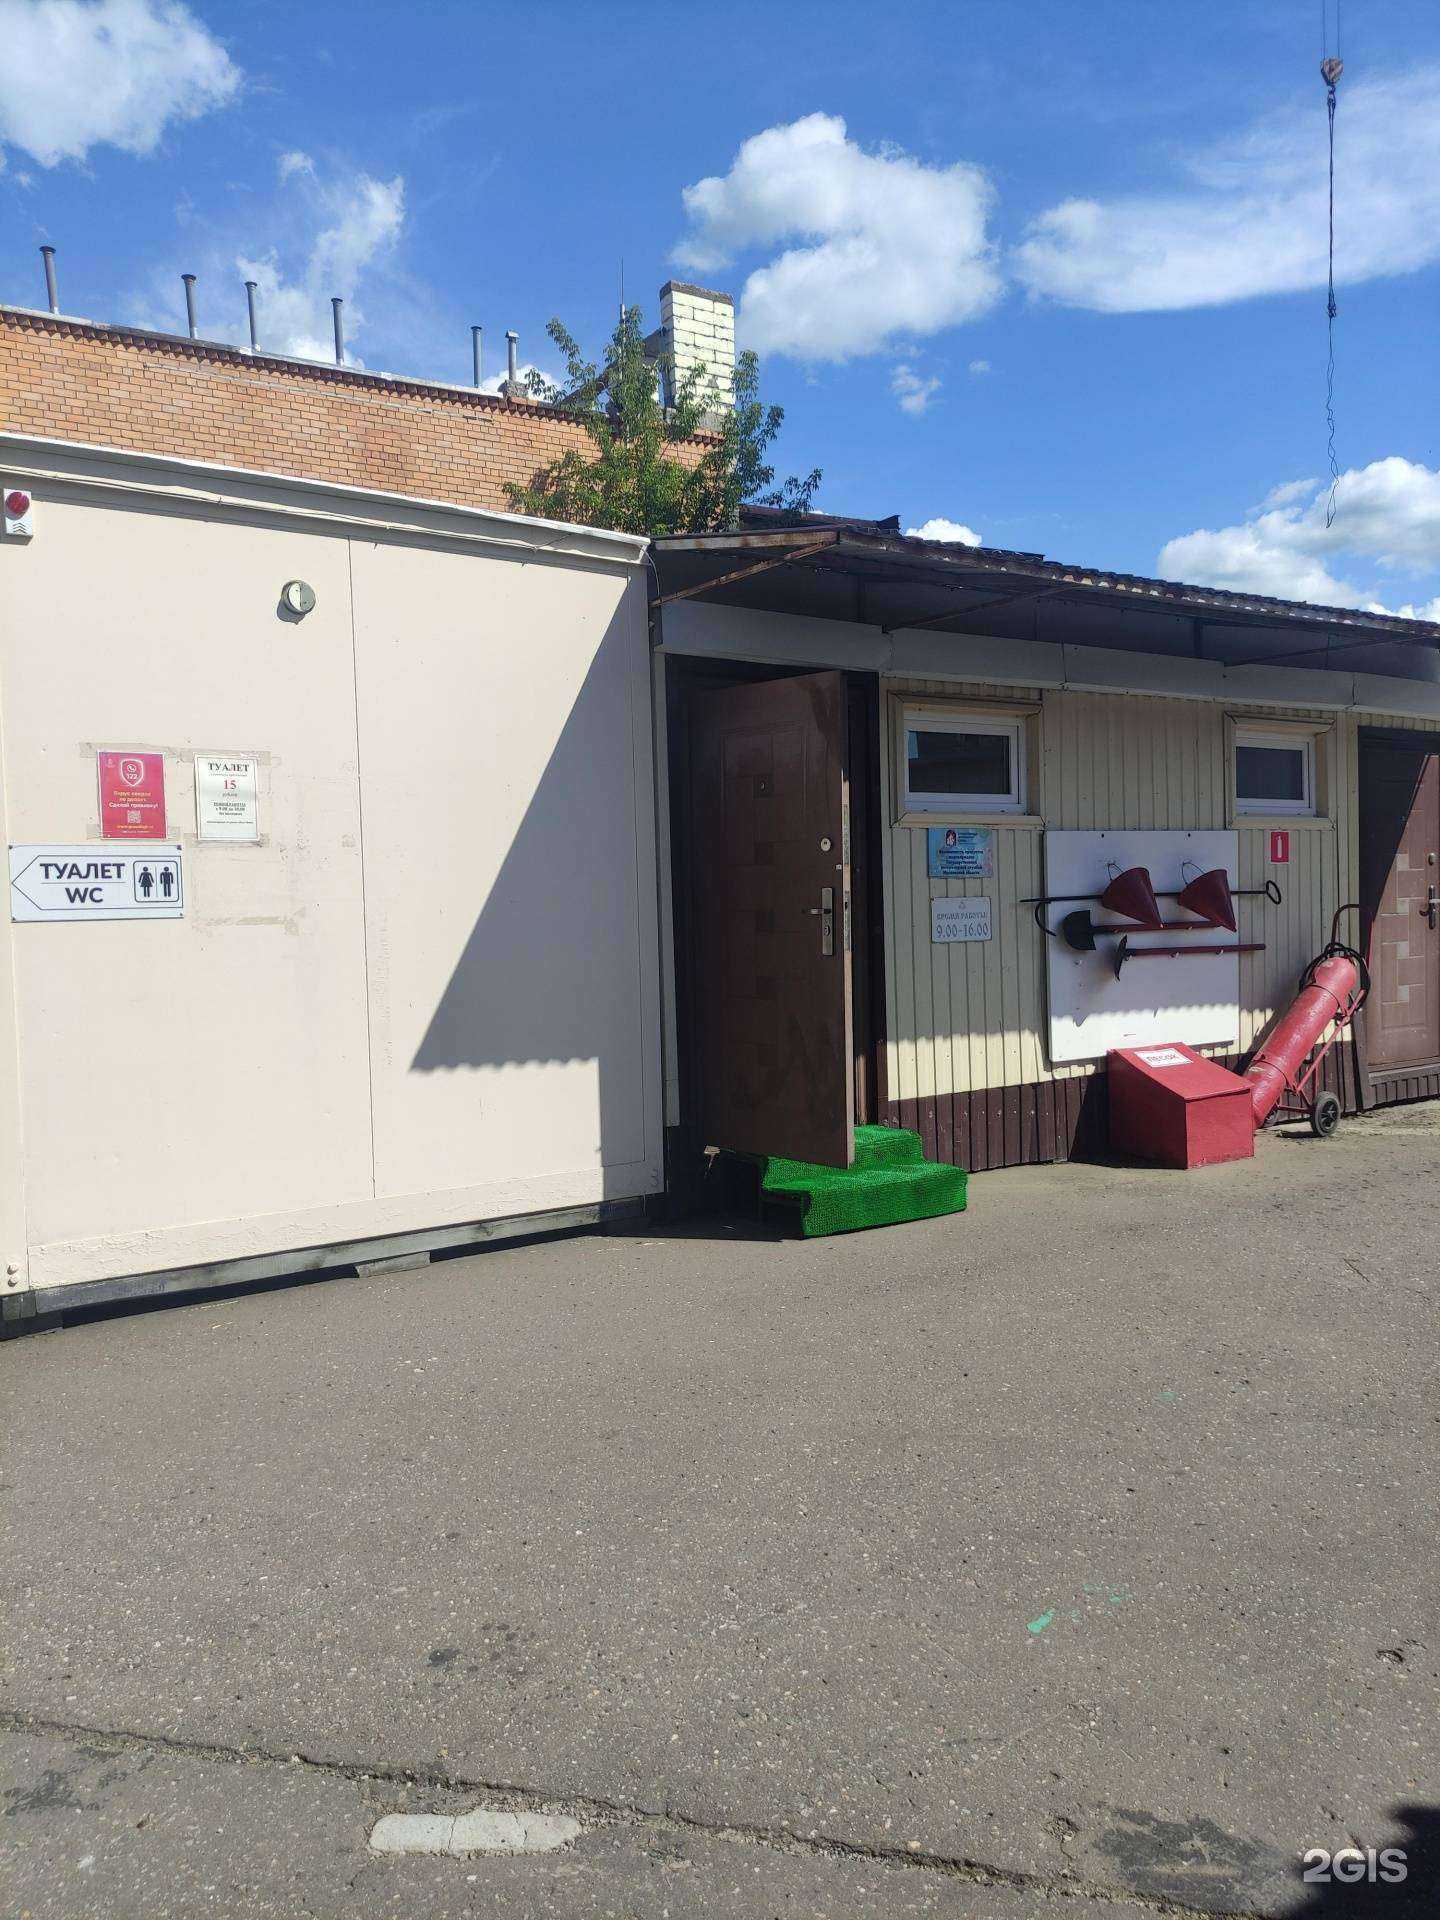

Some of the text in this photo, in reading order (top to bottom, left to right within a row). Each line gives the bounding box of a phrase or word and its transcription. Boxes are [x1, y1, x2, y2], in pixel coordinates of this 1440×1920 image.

[207, 762, 249, 772] ТУАЛЕТ
[223, 779, 237, 790] 15
[40, 863, 125, 879] ТУАЛЕТ
[65, 887, 104, 903] WC
